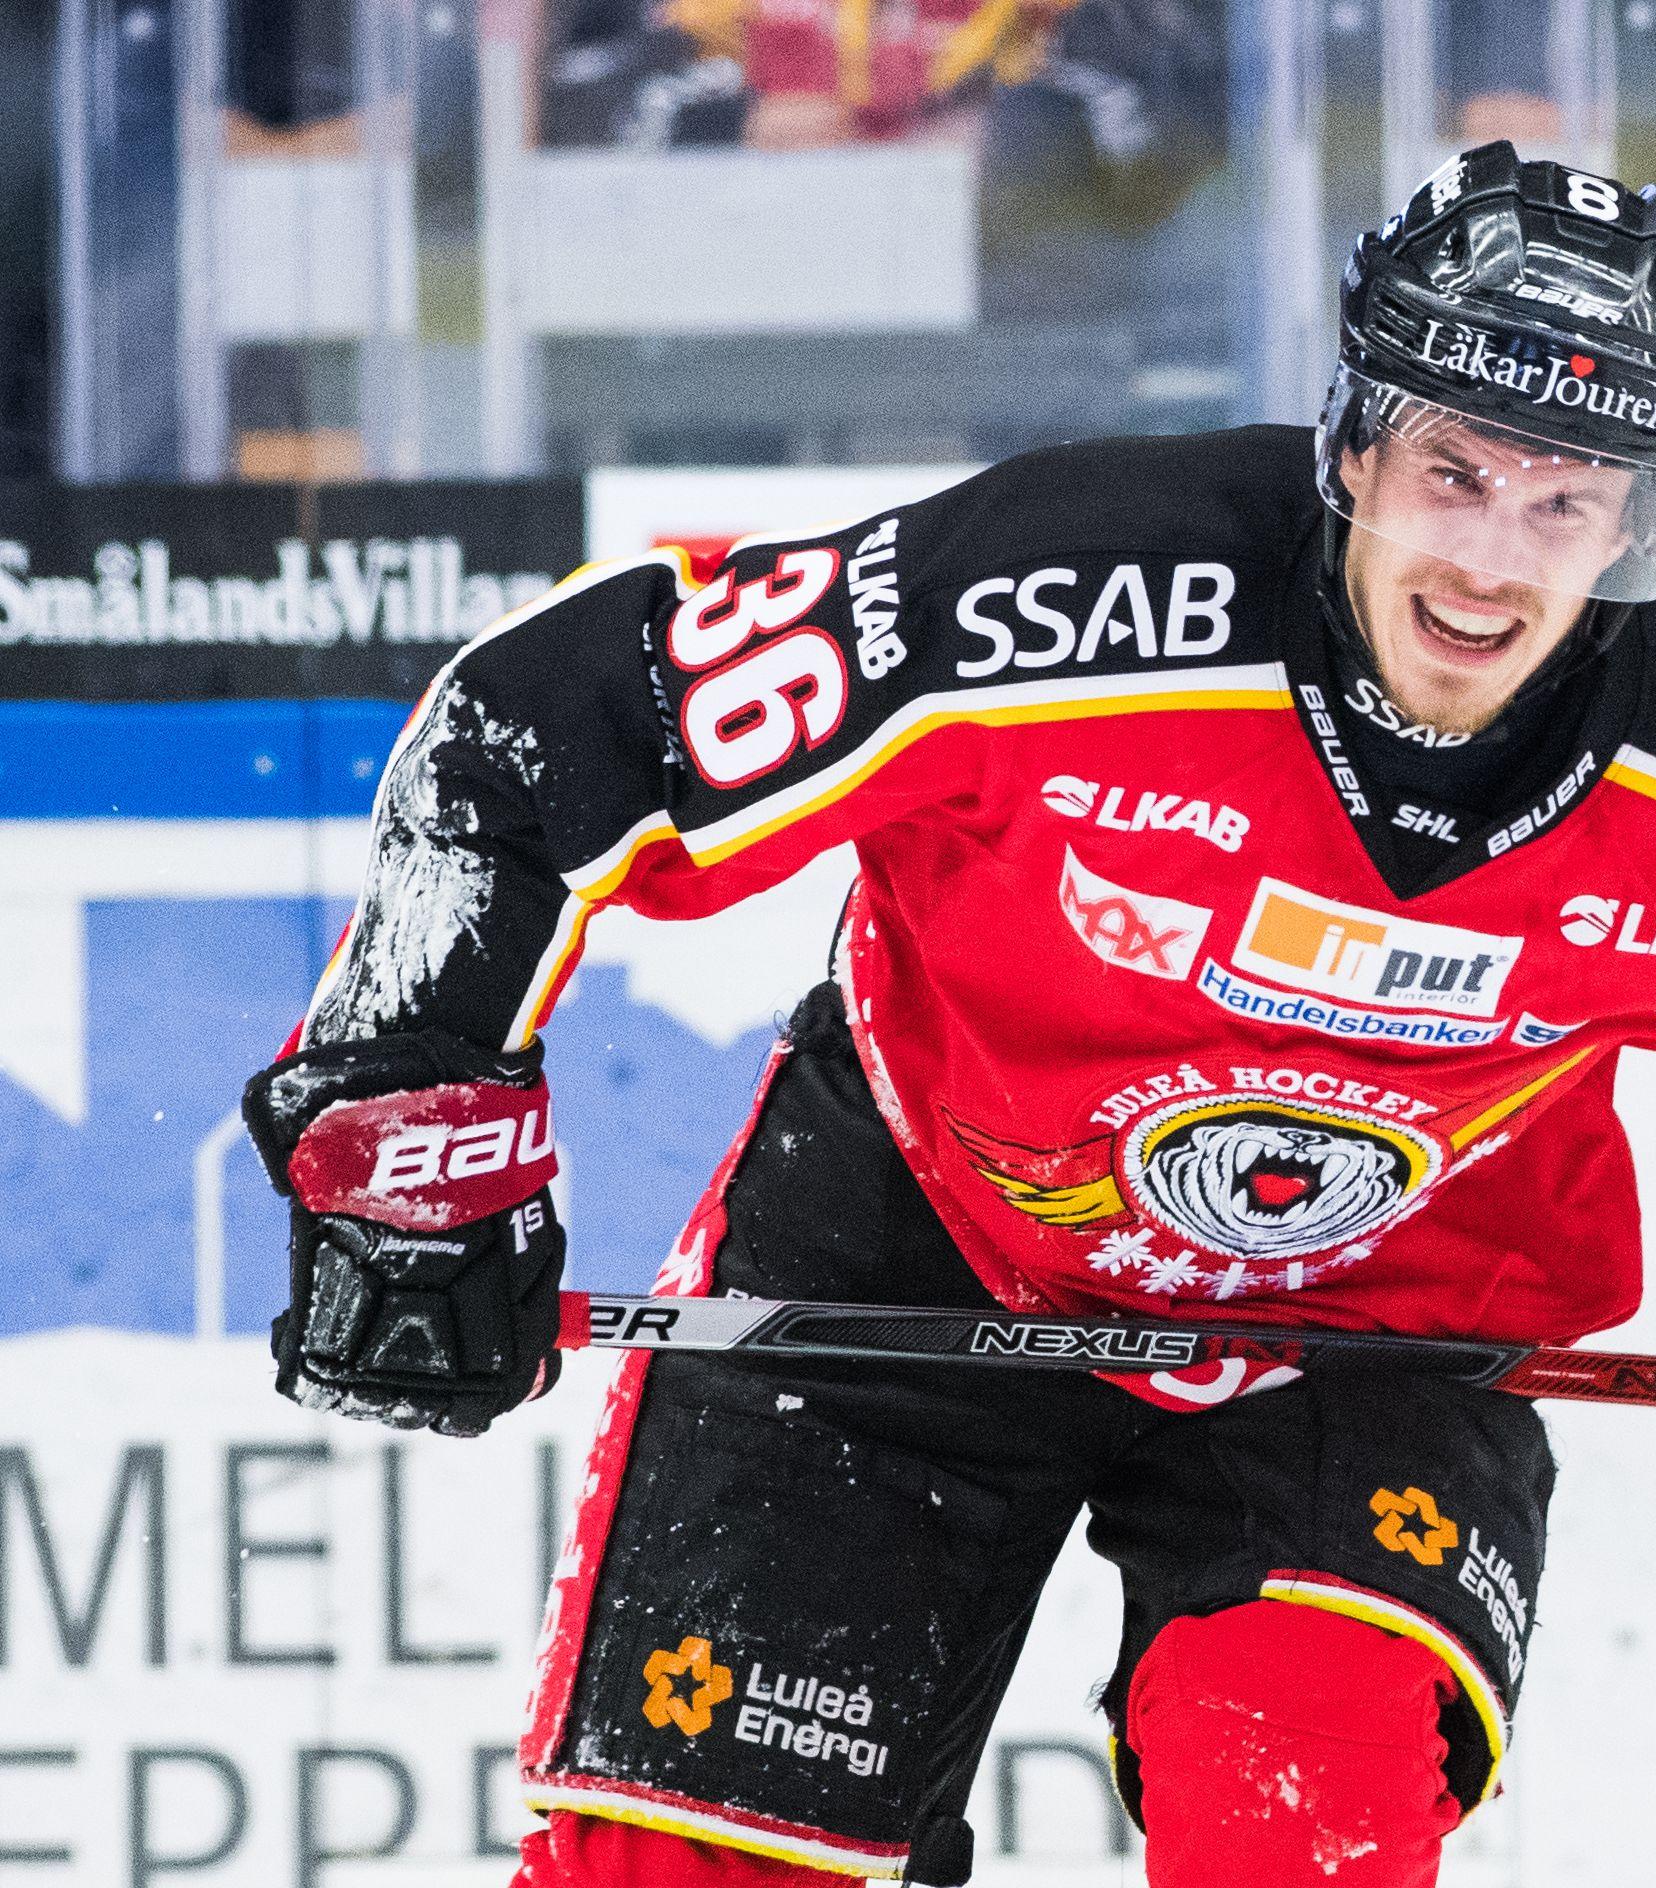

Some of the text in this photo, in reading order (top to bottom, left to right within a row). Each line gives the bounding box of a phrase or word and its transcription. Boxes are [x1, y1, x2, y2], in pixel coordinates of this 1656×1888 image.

[1568, 173, 1620, 222] 8
[847, 547, 908, 681] LKAB
[955, 562, 1236, 679] SSAB
[666, 547, 849, 790] 36
[1095, 786, 1251, 853] LKAB
[1391, 804, 1460, 844] SHL
[1089, 1062, 1439, 1131] LULEÅ HOCKEY
[969, 1321, 1200, 1364] NEXUS
[745, 1662, 874, 1728] Luleå
[734, 1704, 889, 1777] Energi
